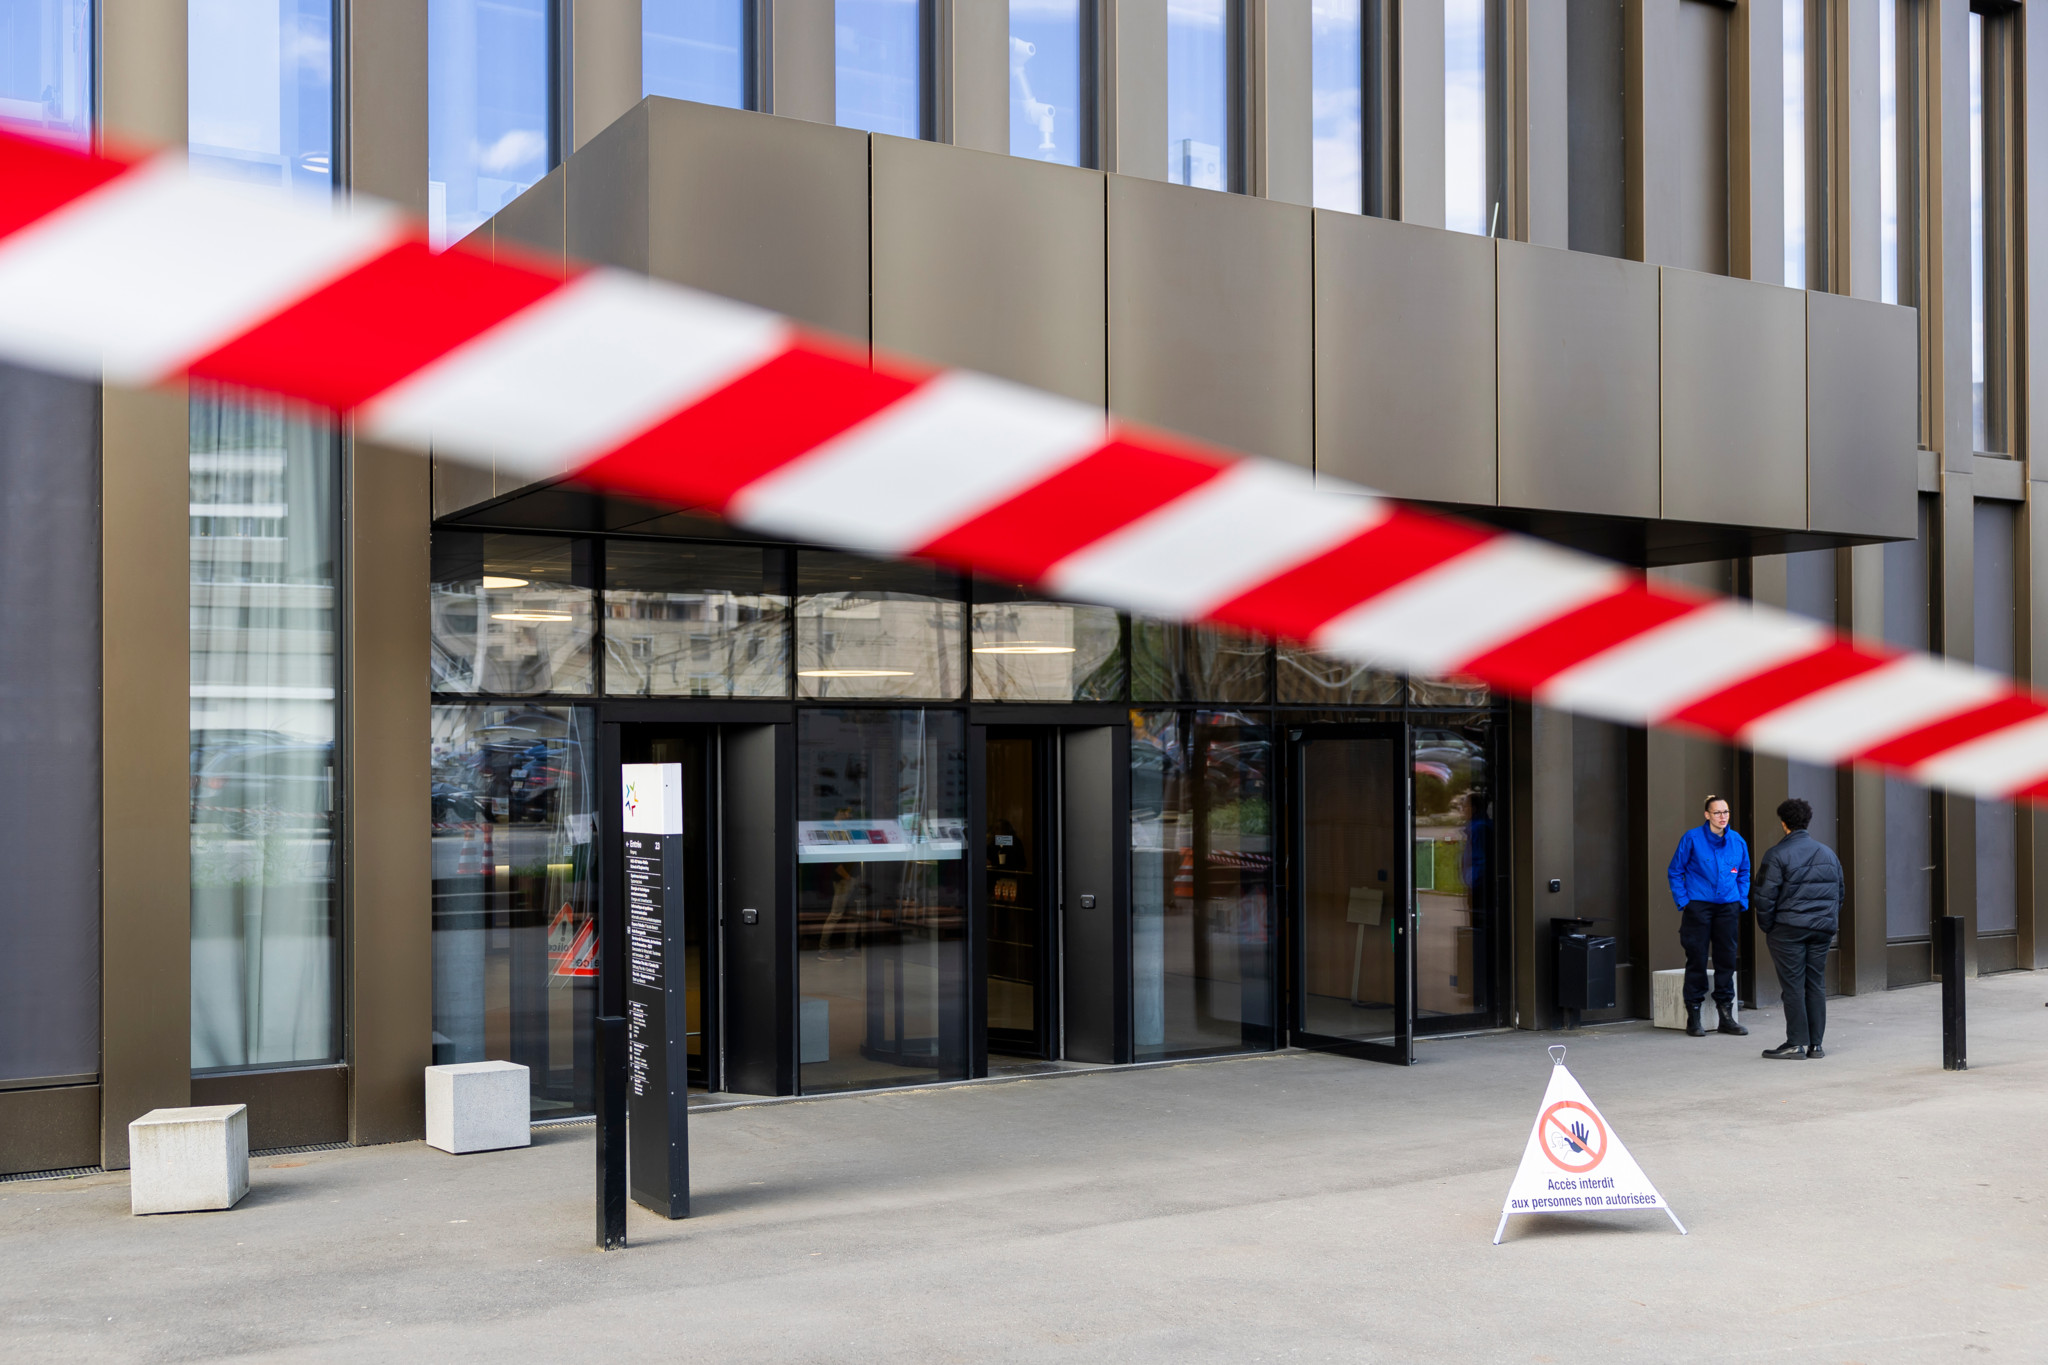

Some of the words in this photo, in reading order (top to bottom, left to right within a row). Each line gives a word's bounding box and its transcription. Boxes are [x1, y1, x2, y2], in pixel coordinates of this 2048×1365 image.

[654, 841, 661, 850] 23
[1548, 1178, 1577, 1191] Accès
[1579, 1177, 1615, 1190] interdit
[1511, 1199, 1529, 1209] aux
[1532, 1196, 1582, 1210] personnes
[1585, 1195, 1603, 1206] non
[1605, 1192, 1656, 1205] autorisées
